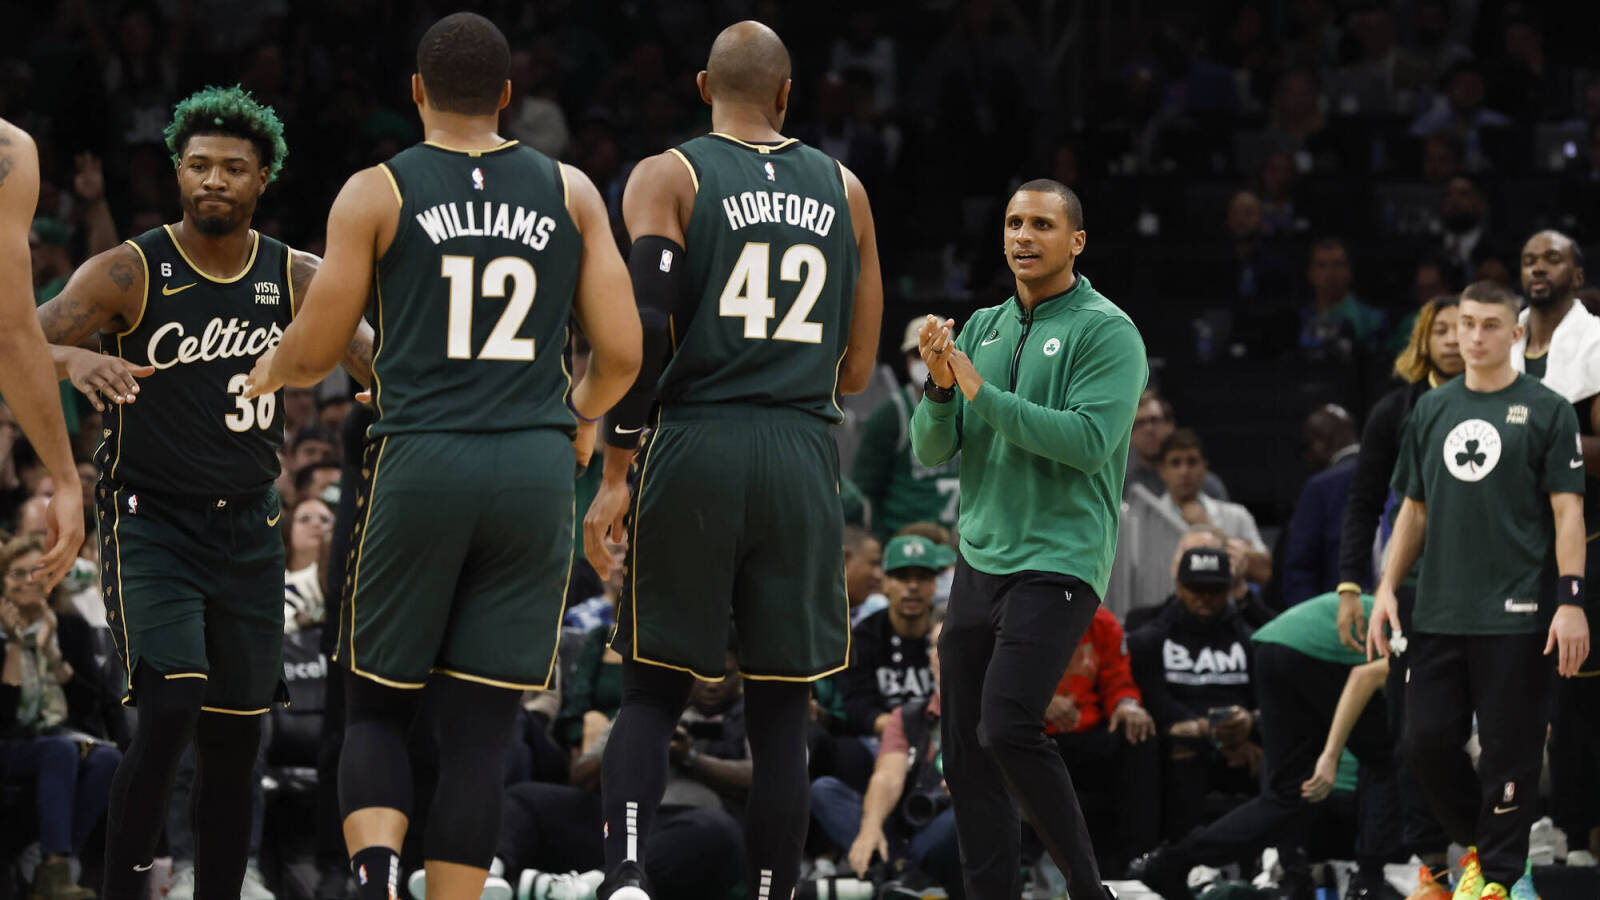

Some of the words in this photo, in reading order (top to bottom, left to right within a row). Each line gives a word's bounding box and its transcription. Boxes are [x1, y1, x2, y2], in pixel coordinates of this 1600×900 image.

[415, 200, 557, 251] WILLIAMS
[722, 190, 836, 238] HORFORD
[160, 262, 172, 277] 6
[254, 281, 280, 295] VISTA
[719, 241, 827, 344] 42
[254, 294, 280, 305] PRINT
[440, 254, 537, 361] 12
[147, 317, 284, 370] Celtics
[1162, 638, 1248, 674] BAM
